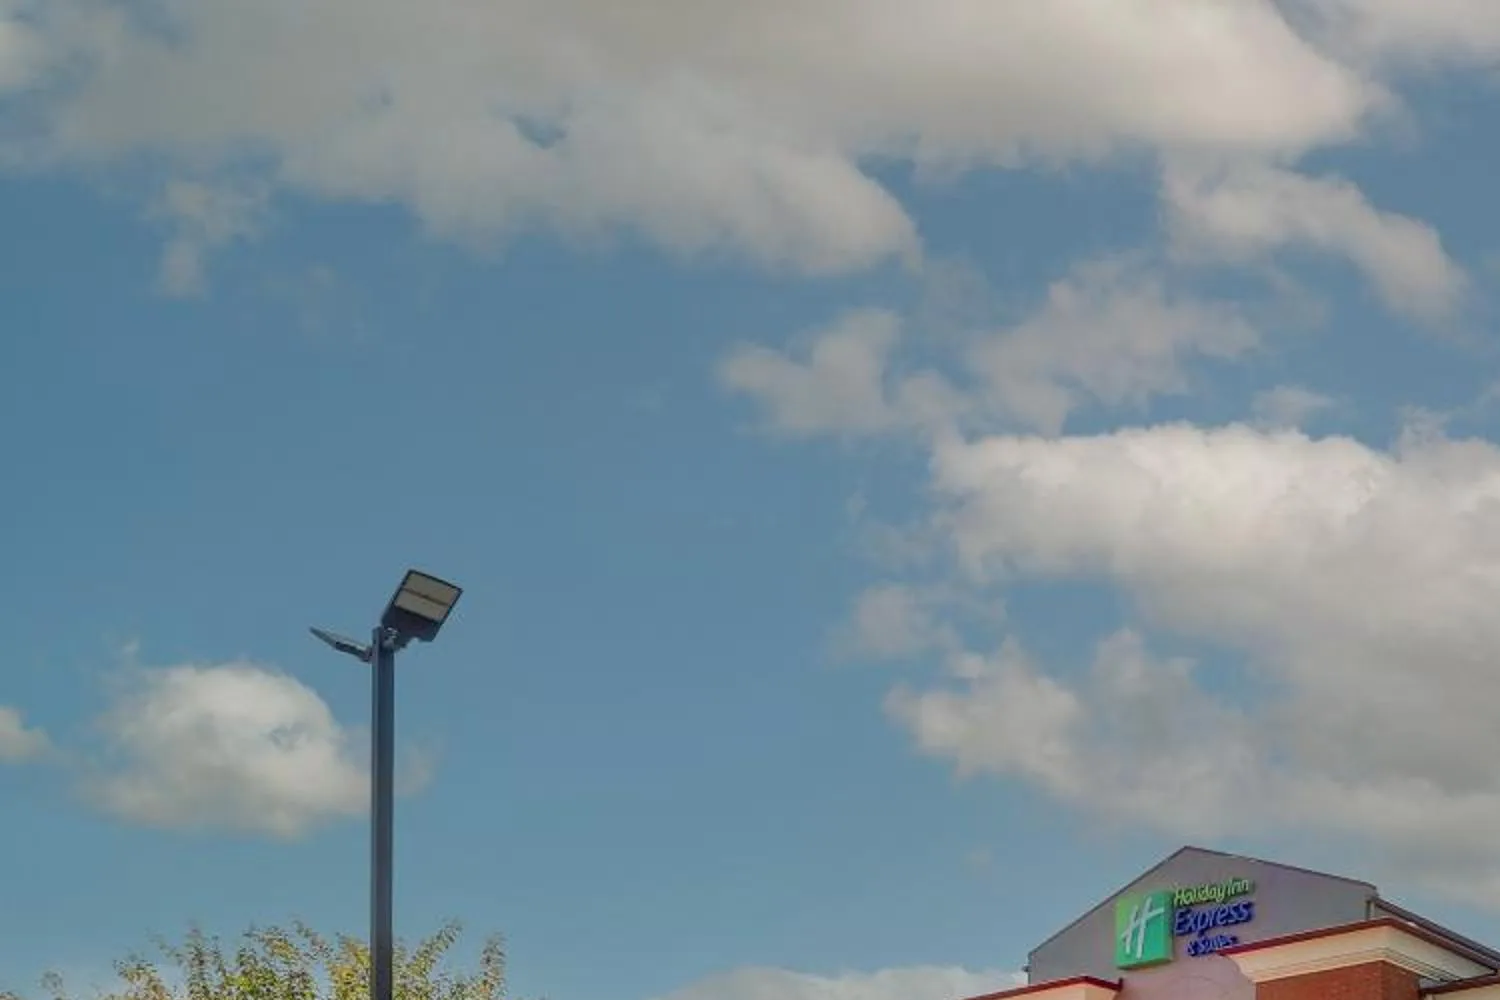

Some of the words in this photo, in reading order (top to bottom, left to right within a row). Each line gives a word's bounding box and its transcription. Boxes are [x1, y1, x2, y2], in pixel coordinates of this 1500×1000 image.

[1174, 881, 1226, 906] Holiday
[1226, 878, 1252, 897] Inn
[1174, 900, 1252, 935] Express
